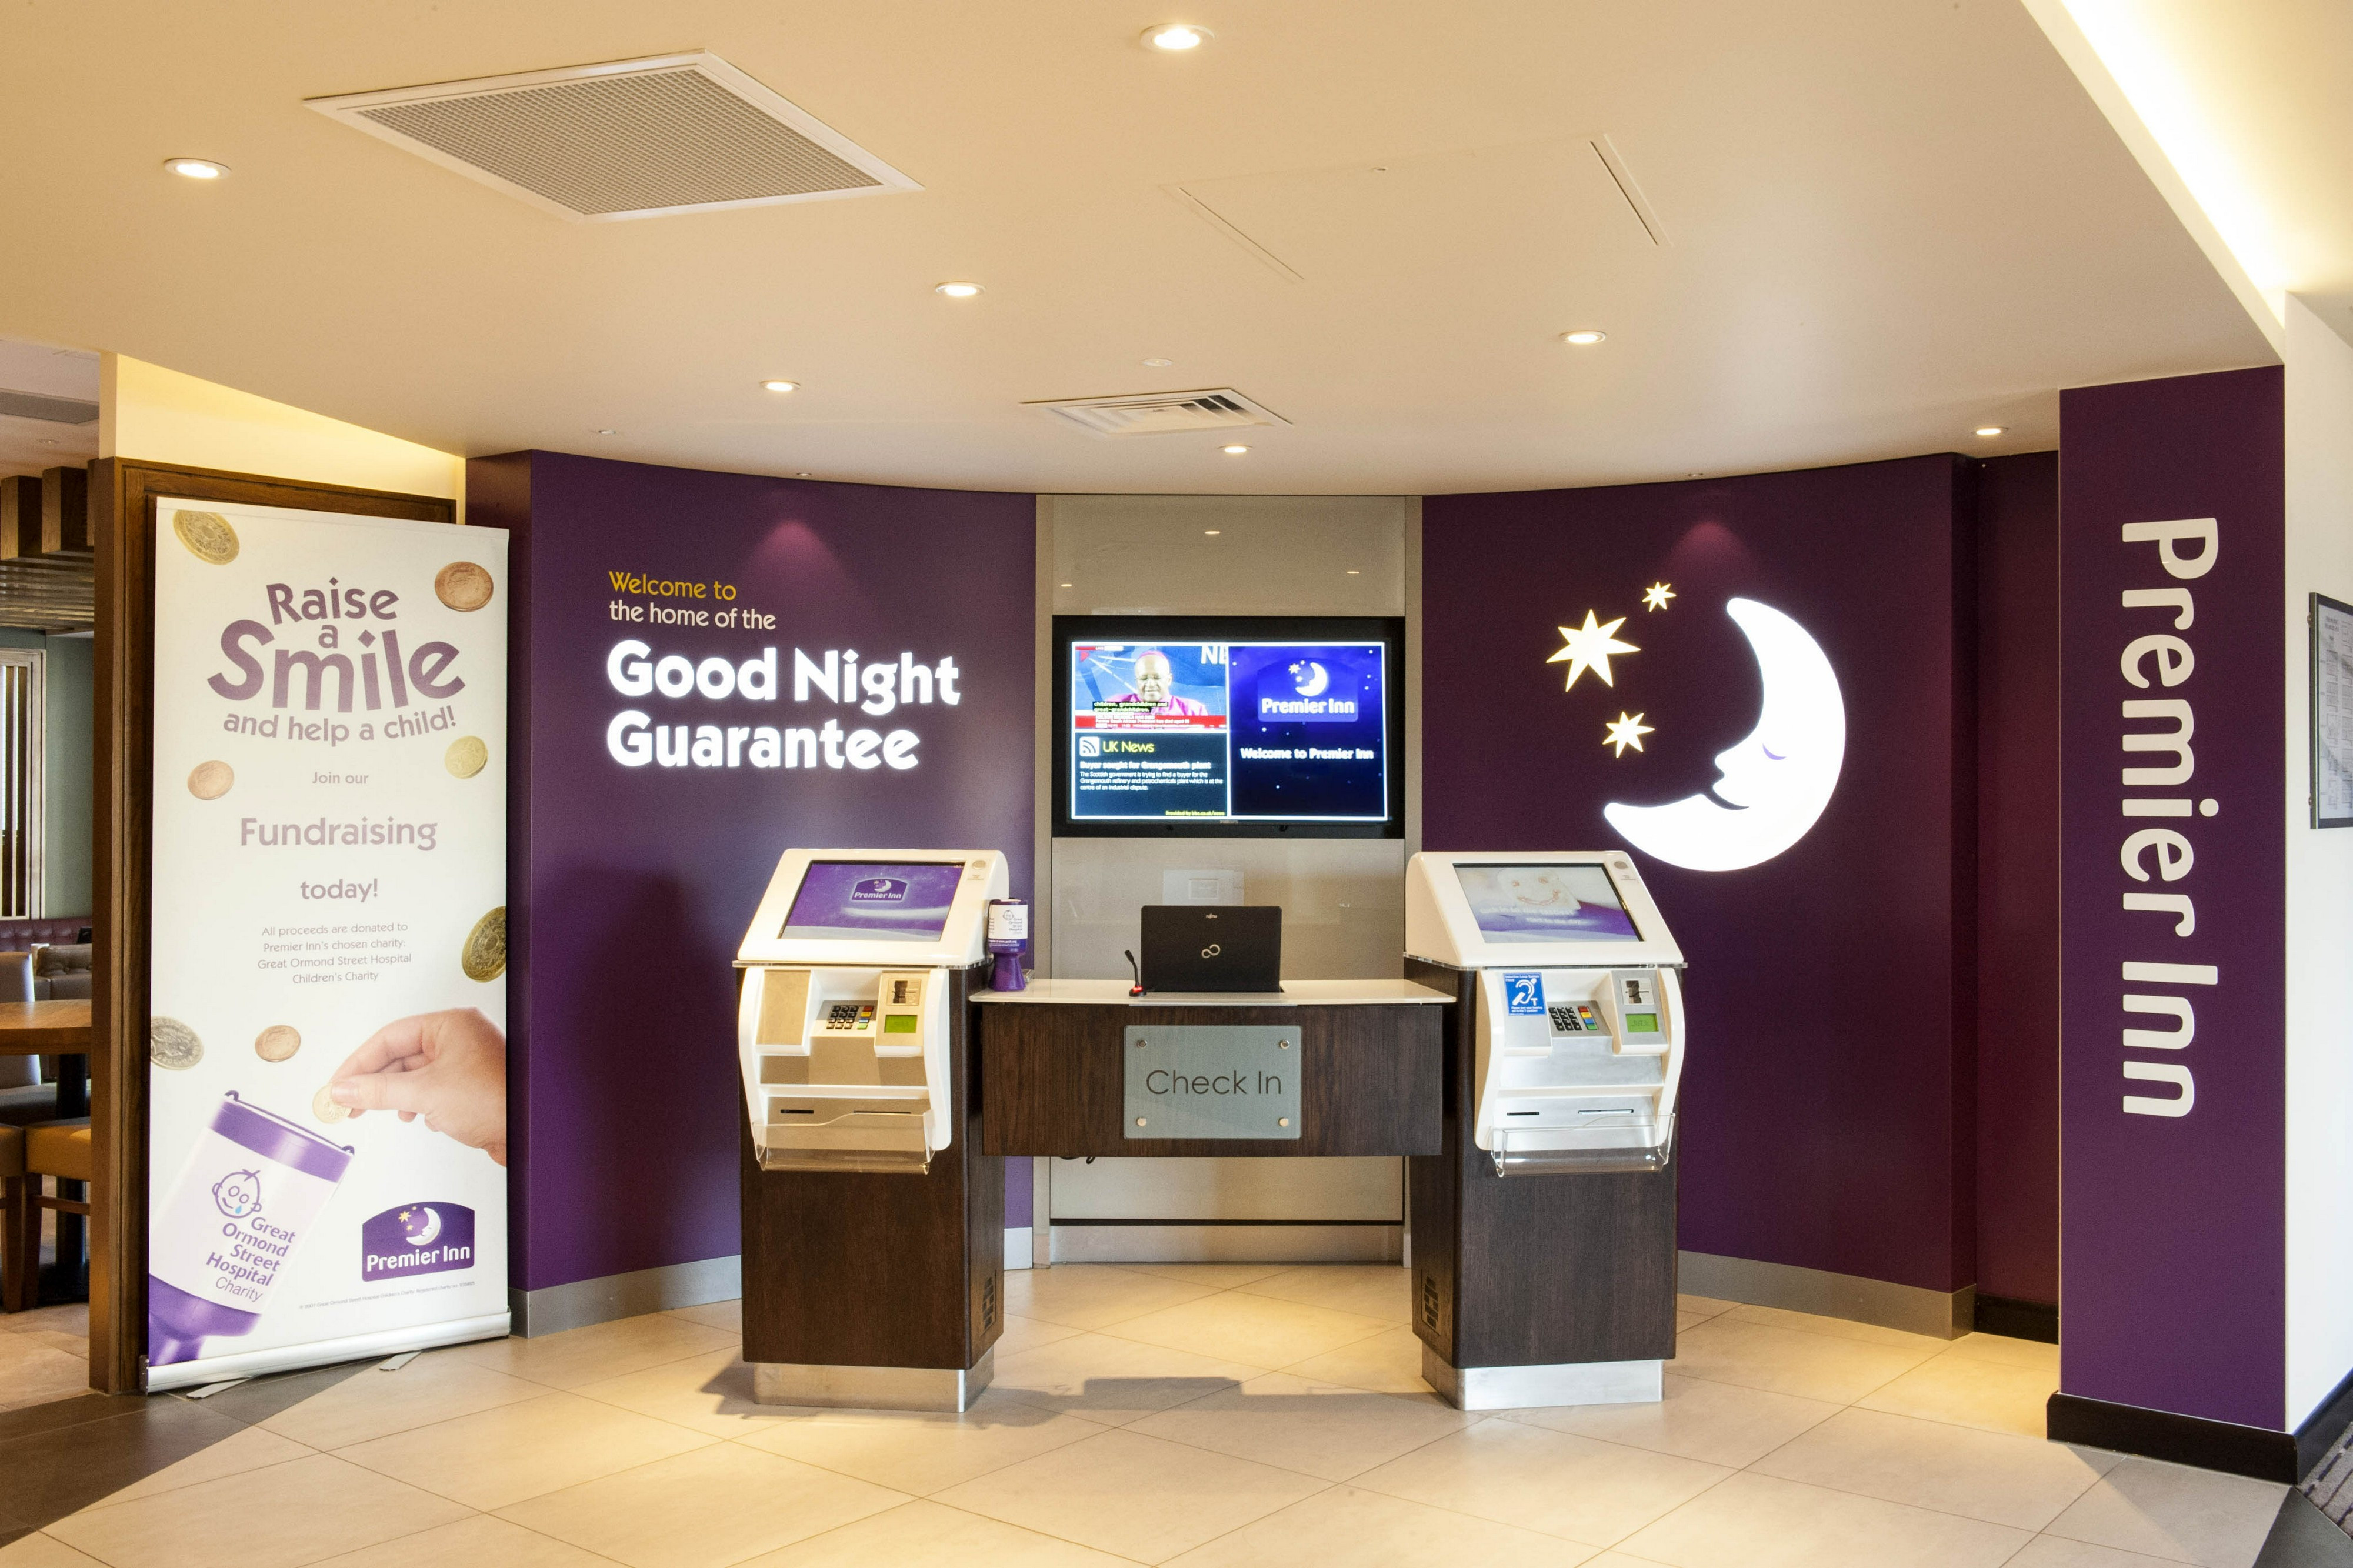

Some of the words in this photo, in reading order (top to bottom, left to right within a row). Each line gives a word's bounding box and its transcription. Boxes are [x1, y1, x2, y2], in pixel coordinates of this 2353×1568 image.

[608, 571, 706, 599] Welcome
[714, 580, 736, 601] to
[266, 577, 399, 625] Raise
[609, 600, 644, 622] the
[649, 603, 709, 626] home
[715, 608, 738, 629] of
[742, 608, 776, 630] the
[318, 625, 338, 649] a
[207, 619, 465, 713] Smile
[607, 639, 777, 701] Good
[794, 646, 961, 715] Night
[1262, 698, 1327, 713] Premier
[1329, 698, 1354, 713] Inn
[224, 713, 279, 738] and
[288, 716, 350, 747] help
[359, 719, 374, 740] a
[384, 705, 456, 739] child!
[2120, 518, 2218, 937] Premier
[606, 710, 920, 770] Guarantee
[1102, 741, 1118, 753] UK
[1122, 741, 1155, 753] News
[1240, 748, 1292, 759] Welcome
[1294, 748, 1307, 759] to
[1309, 748, 1354, 759] Premier
[1356, 748, 1374, 759] Inn
[312, 772, 341, 784] Join
[345, 774, 369, 784] our
[241, 816, 438, 851] Fundraising
[301, 878, 378, 902] today!
[262, 927, 275, 936] All
[279, 925, 328, 937] proceeds
[351, 923, 394, 933] donated
[264, 943, 302, 952] Premier
[306, 941, 328, 951] Inn's
[332, 940, 367, 950] chosen
[371, 939, 405, 949] charity:
[258, 959, 287, 969] Great
[291, 957, 334, 968] Ormond
[338, 956, 367, 966] Street
[371, 953, 412, 966] Hospital
[292, 972, 342, 983] Children's
[345, 971, 379, 982] Charity
[2122, 961, 2218, 1117] Inn
[1146, 1070, 1247, 1095] Check
[1258, 1071, 1281, 1095] In
[222, 1222, 289, 1257] Ormond
[251, 1217, 296, 1243] Great
[206, 1252, 274, 1286] Hospital
[230, 1243, 281, 1272] Street
[366, 1249, 440, 1272] Premier
[443, 1245, 471, 1263] Inn
[216, 1277, 264, 1303] Charity
